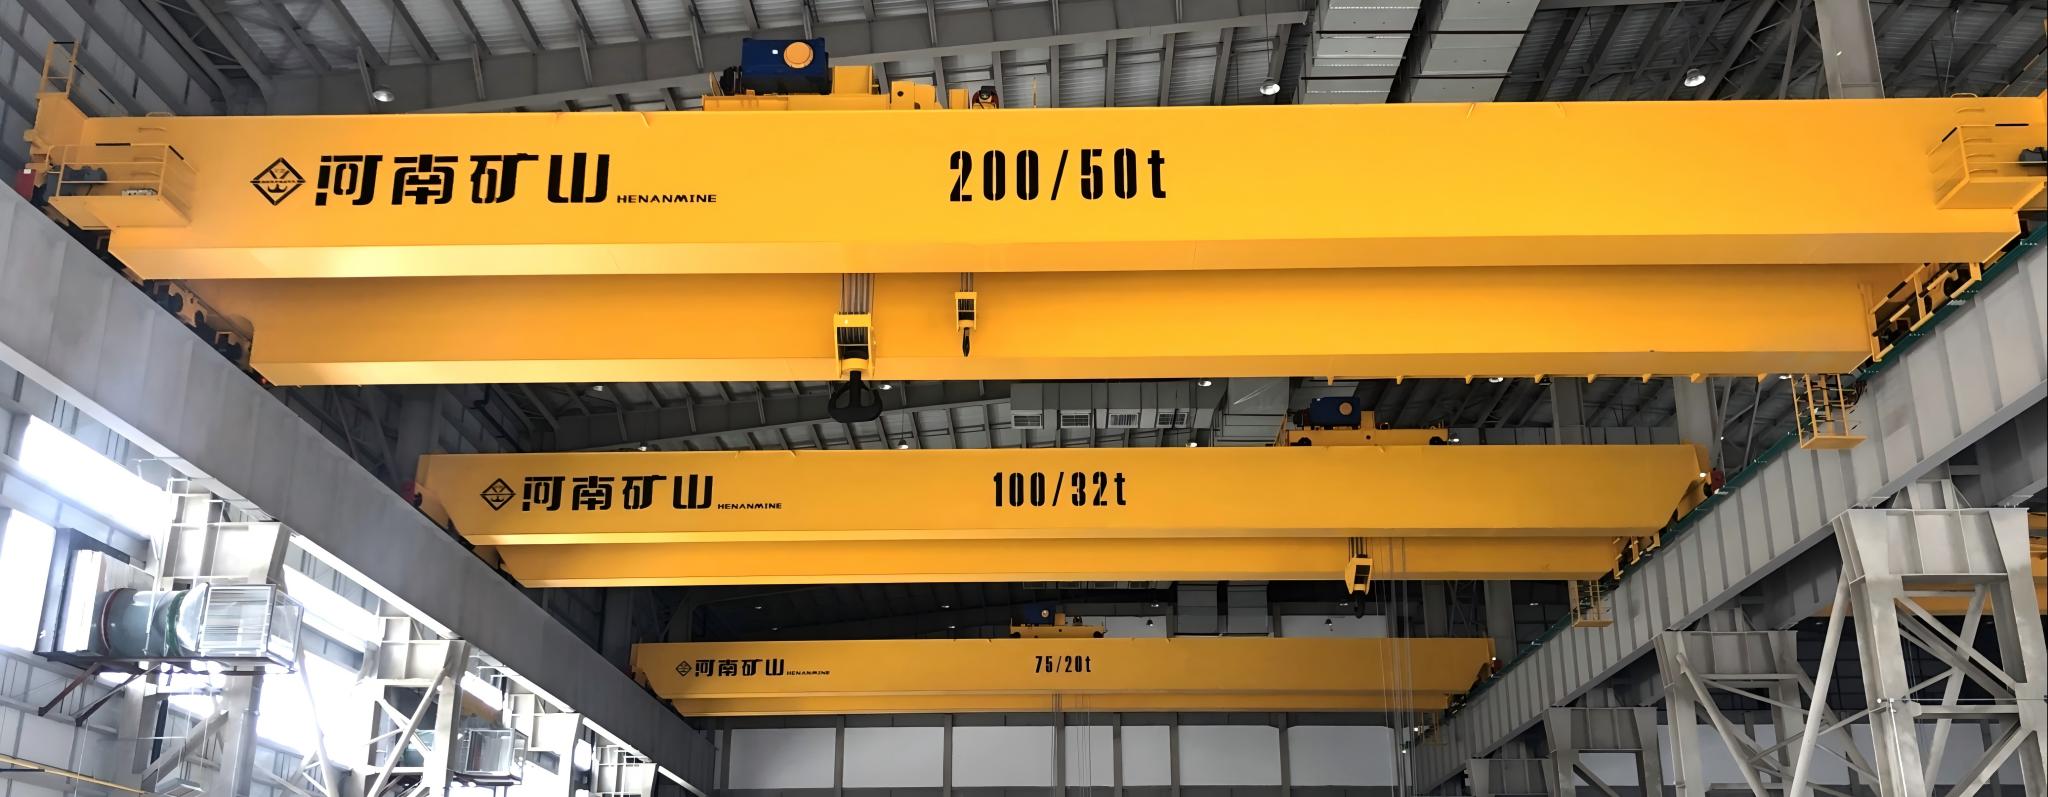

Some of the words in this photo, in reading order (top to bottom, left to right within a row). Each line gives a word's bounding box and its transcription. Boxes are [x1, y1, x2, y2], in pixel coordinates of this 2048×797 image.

[314, 152, 610, 207] 河南矿山
[949, 147, 1167, 202] 200/50t
[616, 194, 717, 204] HENANMINE
[521, 474, 714, 512] 河南矿山
[993, 471, 1127, 507] 100/32t
[717, 502, 782, 510] HENANMINE
[694, 658, 785, 678] 河南矿山
[1035, 655, 1092, 674] 75/20t
